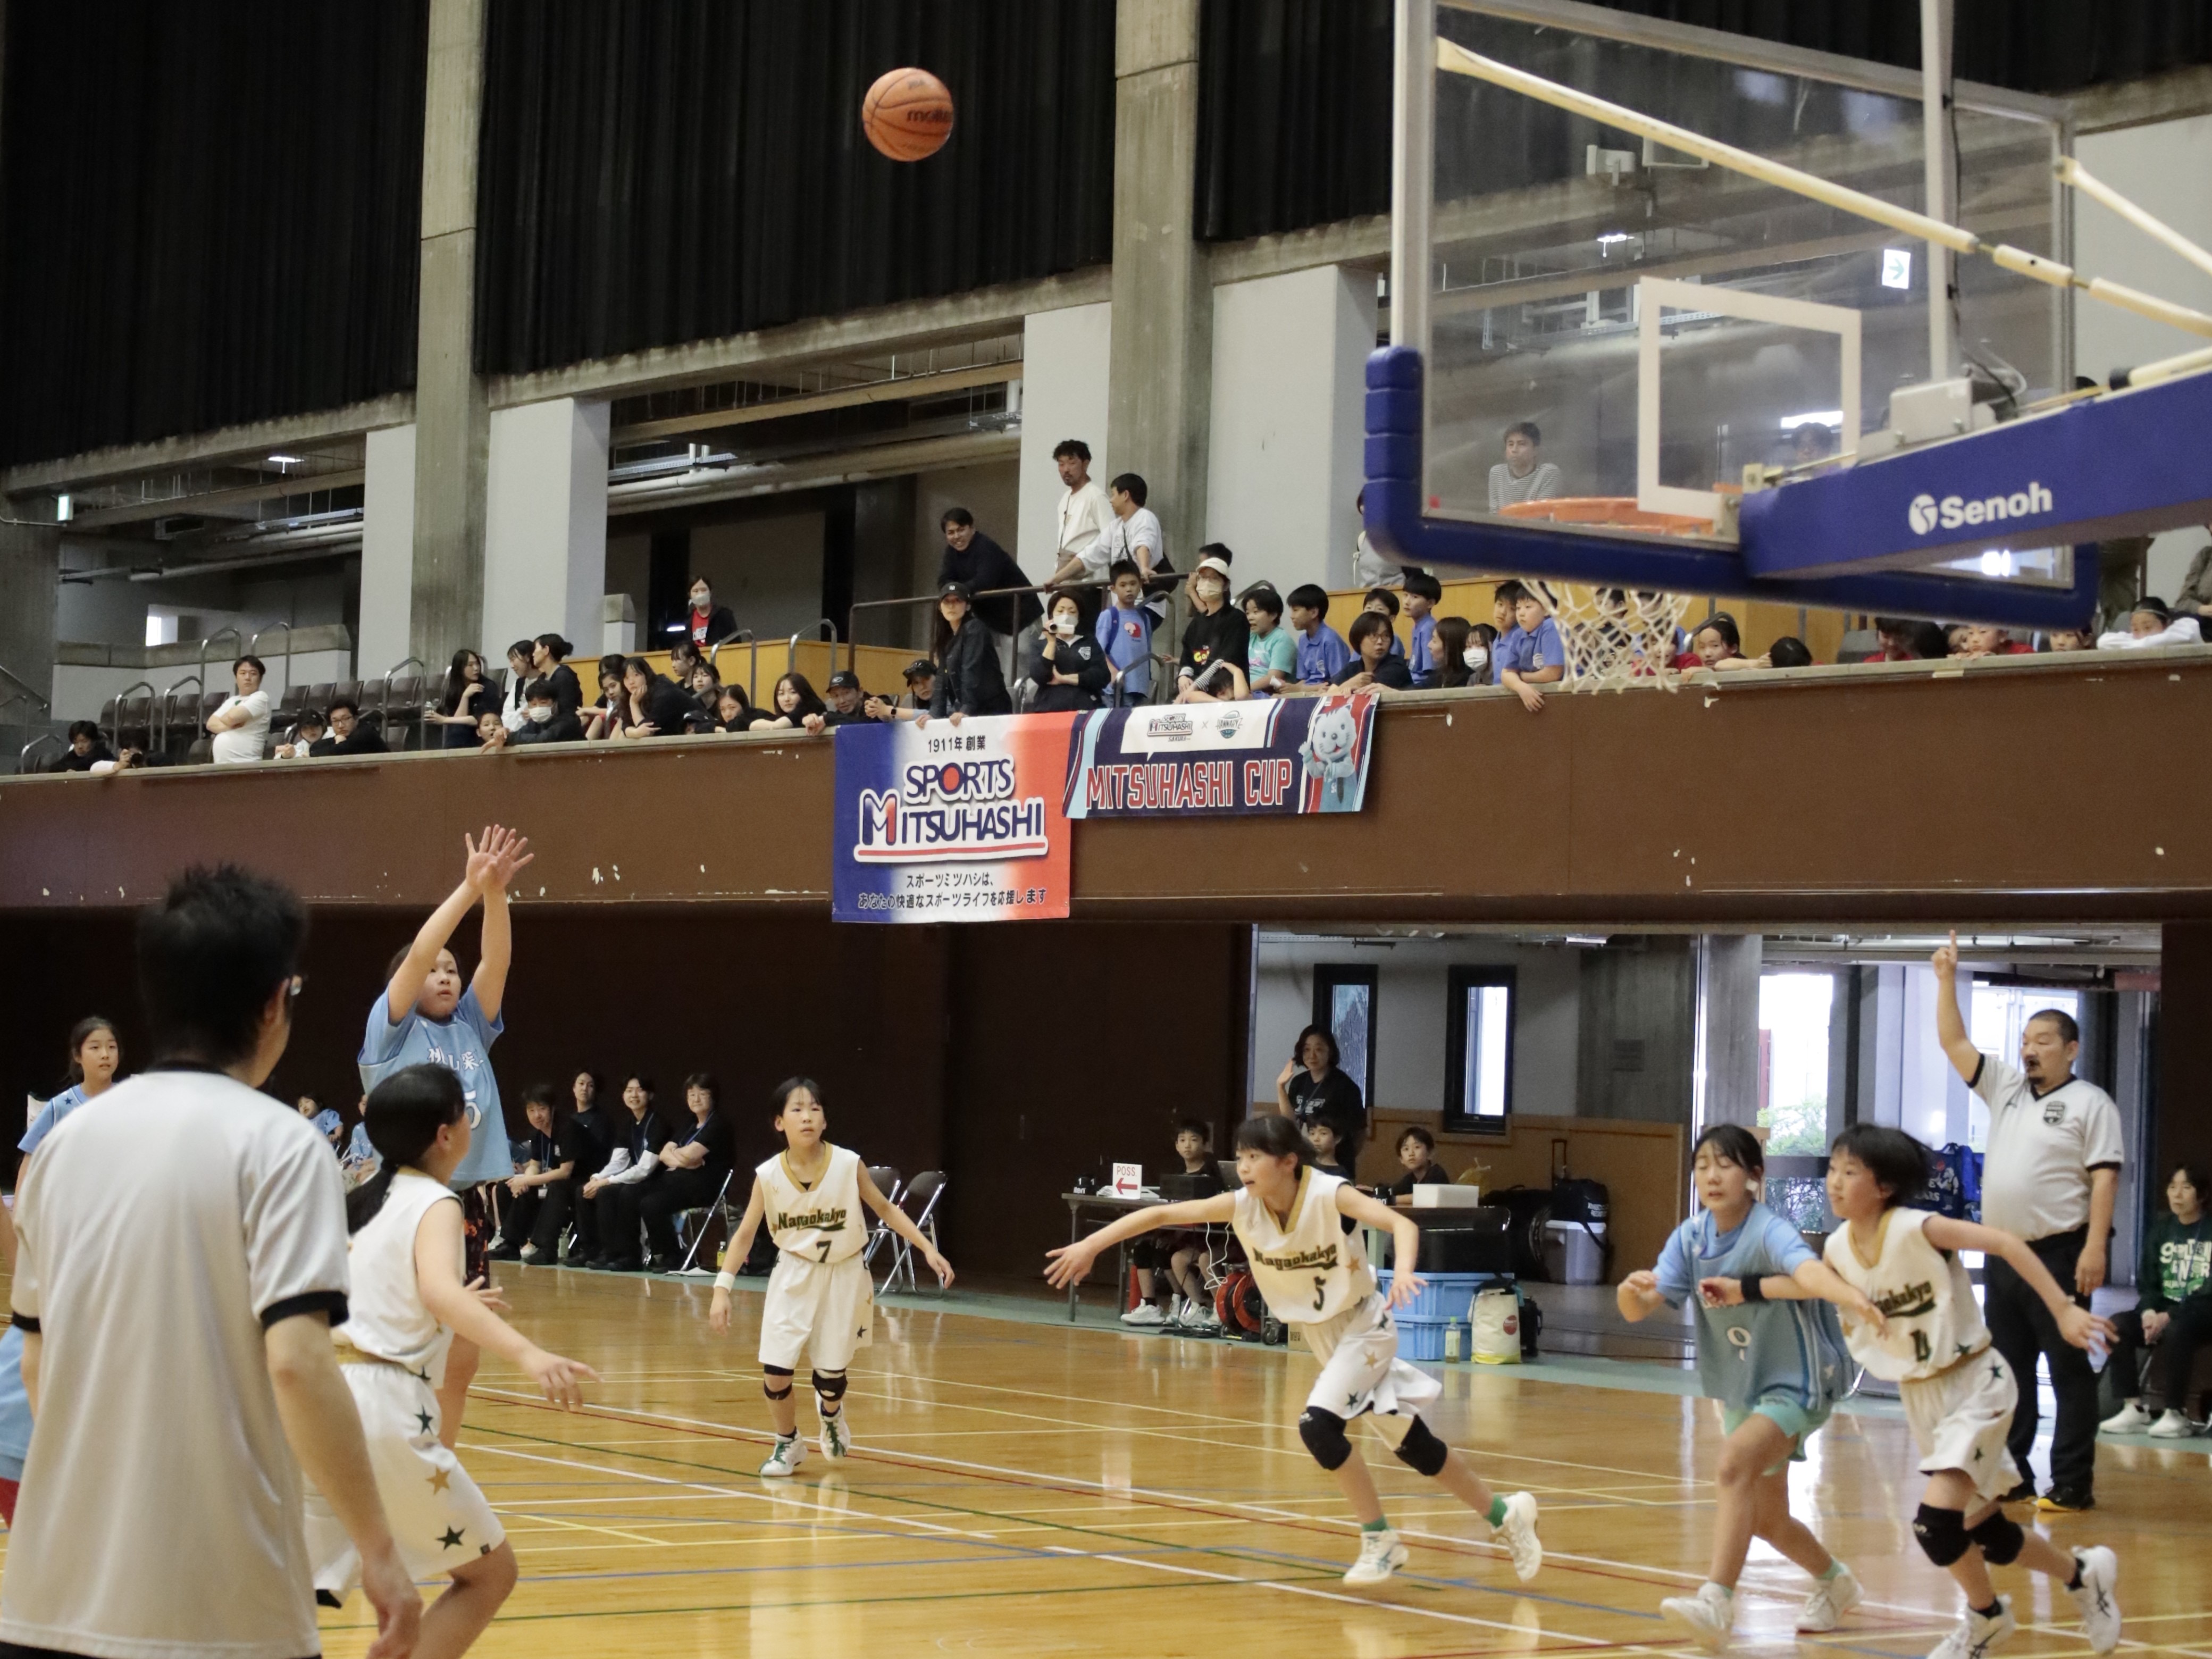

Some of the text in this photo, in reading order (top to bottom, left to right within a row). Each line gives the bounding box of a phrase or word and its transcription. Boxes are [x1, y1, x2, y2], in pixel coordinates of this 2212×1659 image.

[1940, 481, 2053, 529] Senoh
[928, 735, 986, 752] 1911年 創業
[1150, 721, 1191, 732] MITSUHASHI
[907, 759, 1011, 798] SPORTS
[1086, 759, 1293, 809] MITSUHASHI CUP
[862, 792, 1042, 845] MITSUHASHI
[858, 888, 1048, 910] あなたの快適なスポーツライフを応援します
[816, 1239, 832, 1263] 7
[1313, 1276, 1327, 1312] 5
